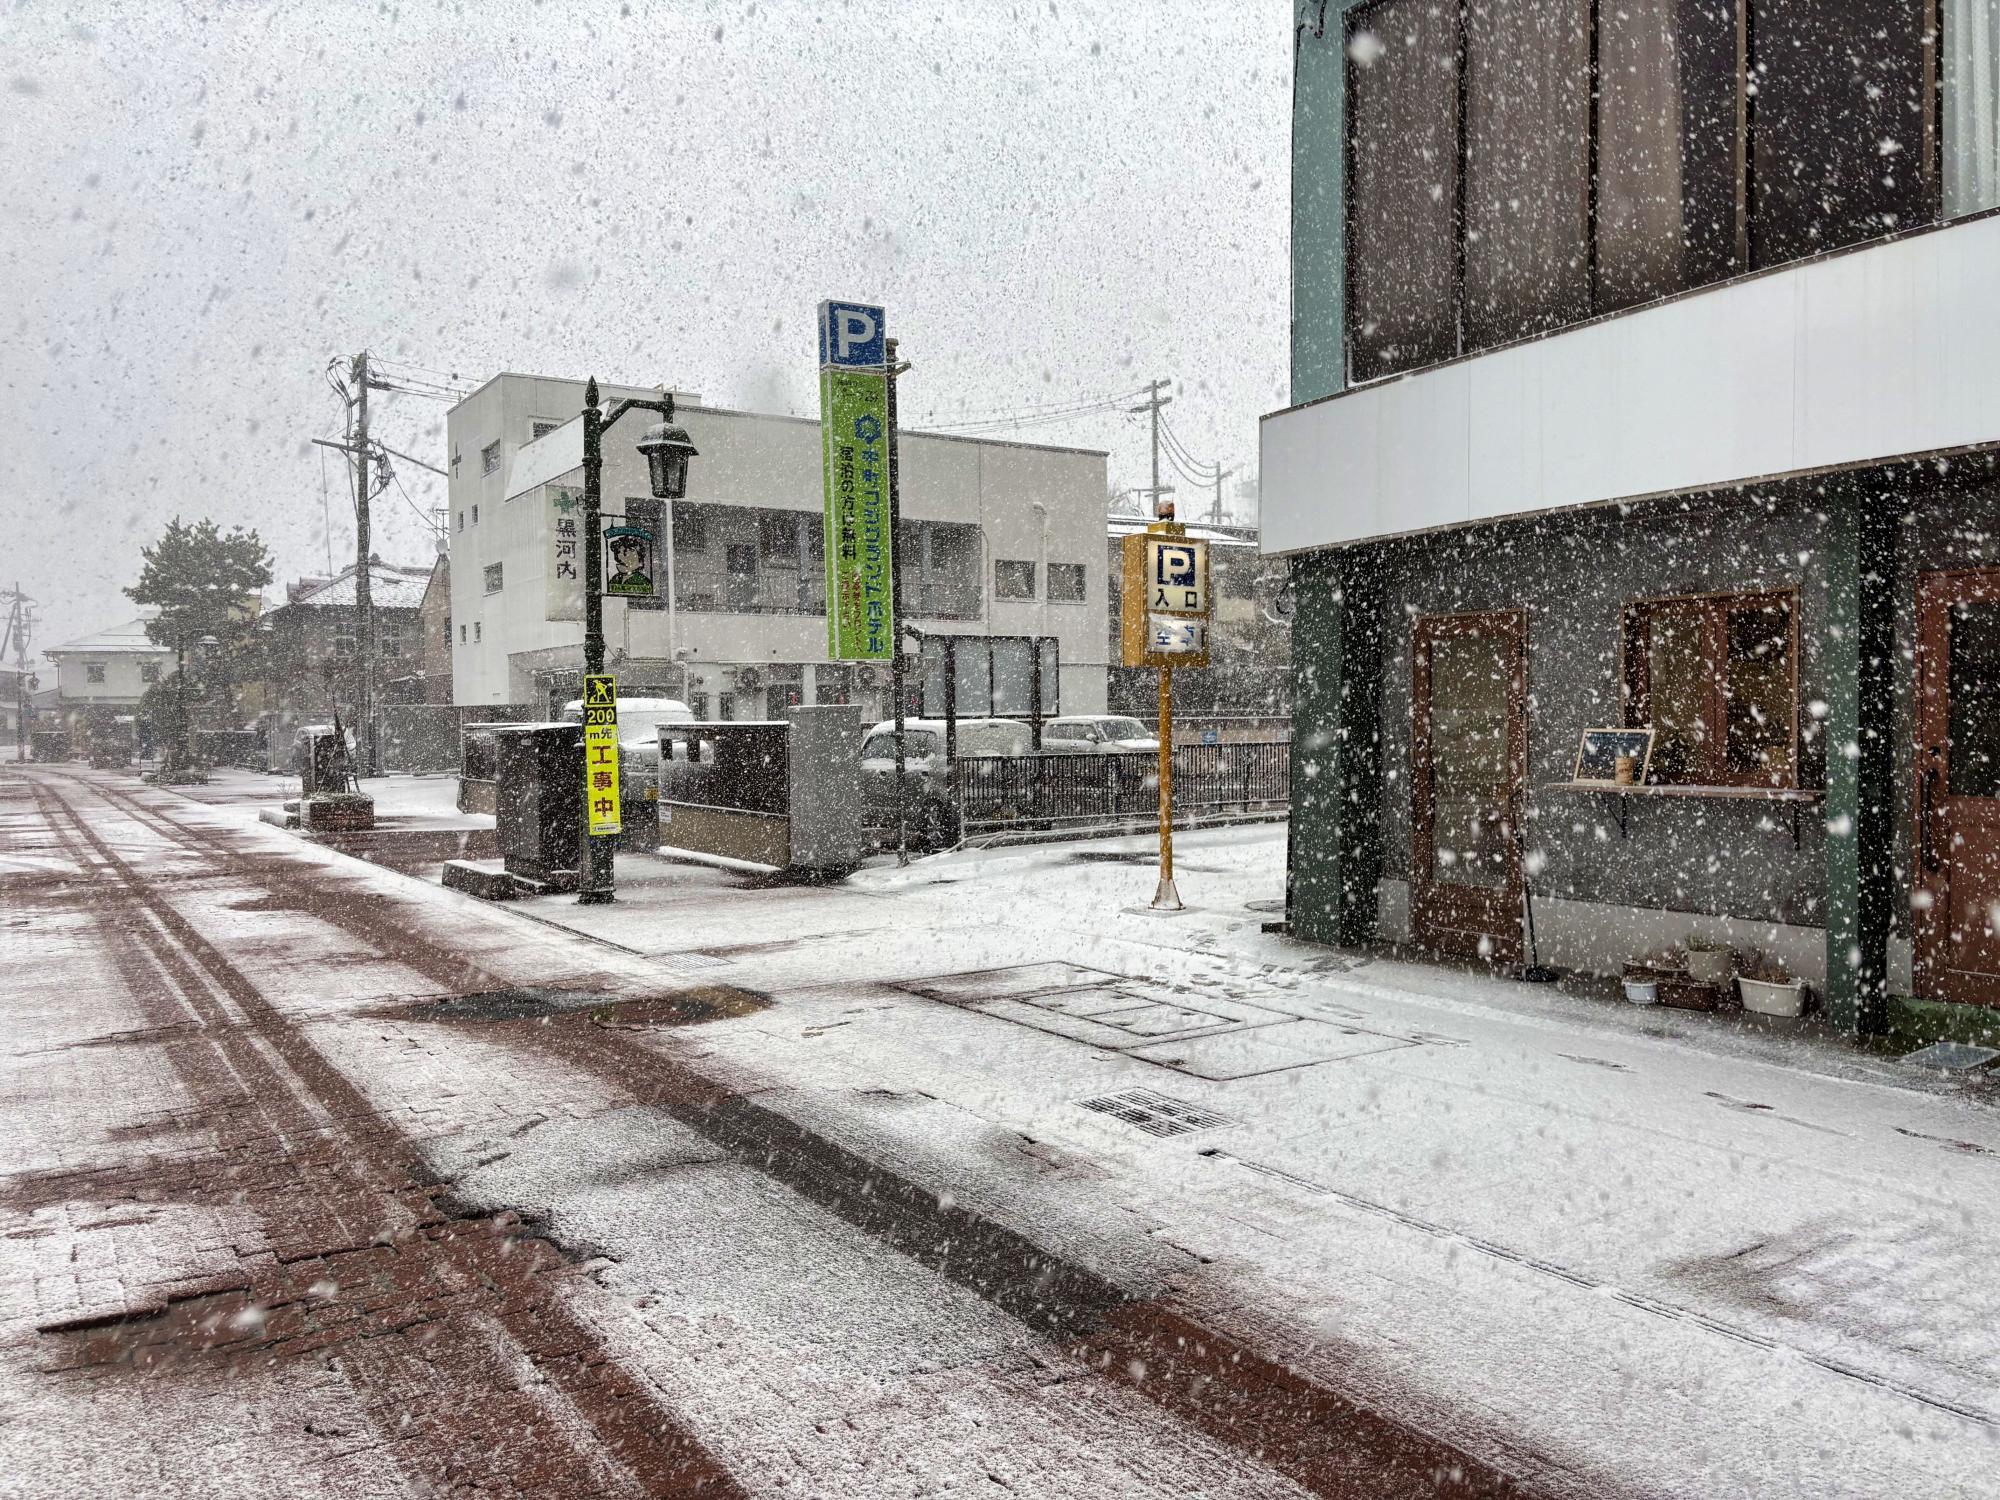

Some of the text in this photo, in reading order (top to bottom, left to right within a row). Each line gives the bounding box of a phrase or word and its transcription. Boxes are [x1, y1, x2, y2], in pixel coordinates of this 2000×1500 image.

[838, 309, 875, 357] P
[1162, 549, 1191, 582] P
[1155, 588, 1198, 608] 入口
[587, 709, 615, 723] 200
[589, 727, 613, 740] m先
[592, 745, 614, 818] 工事中
